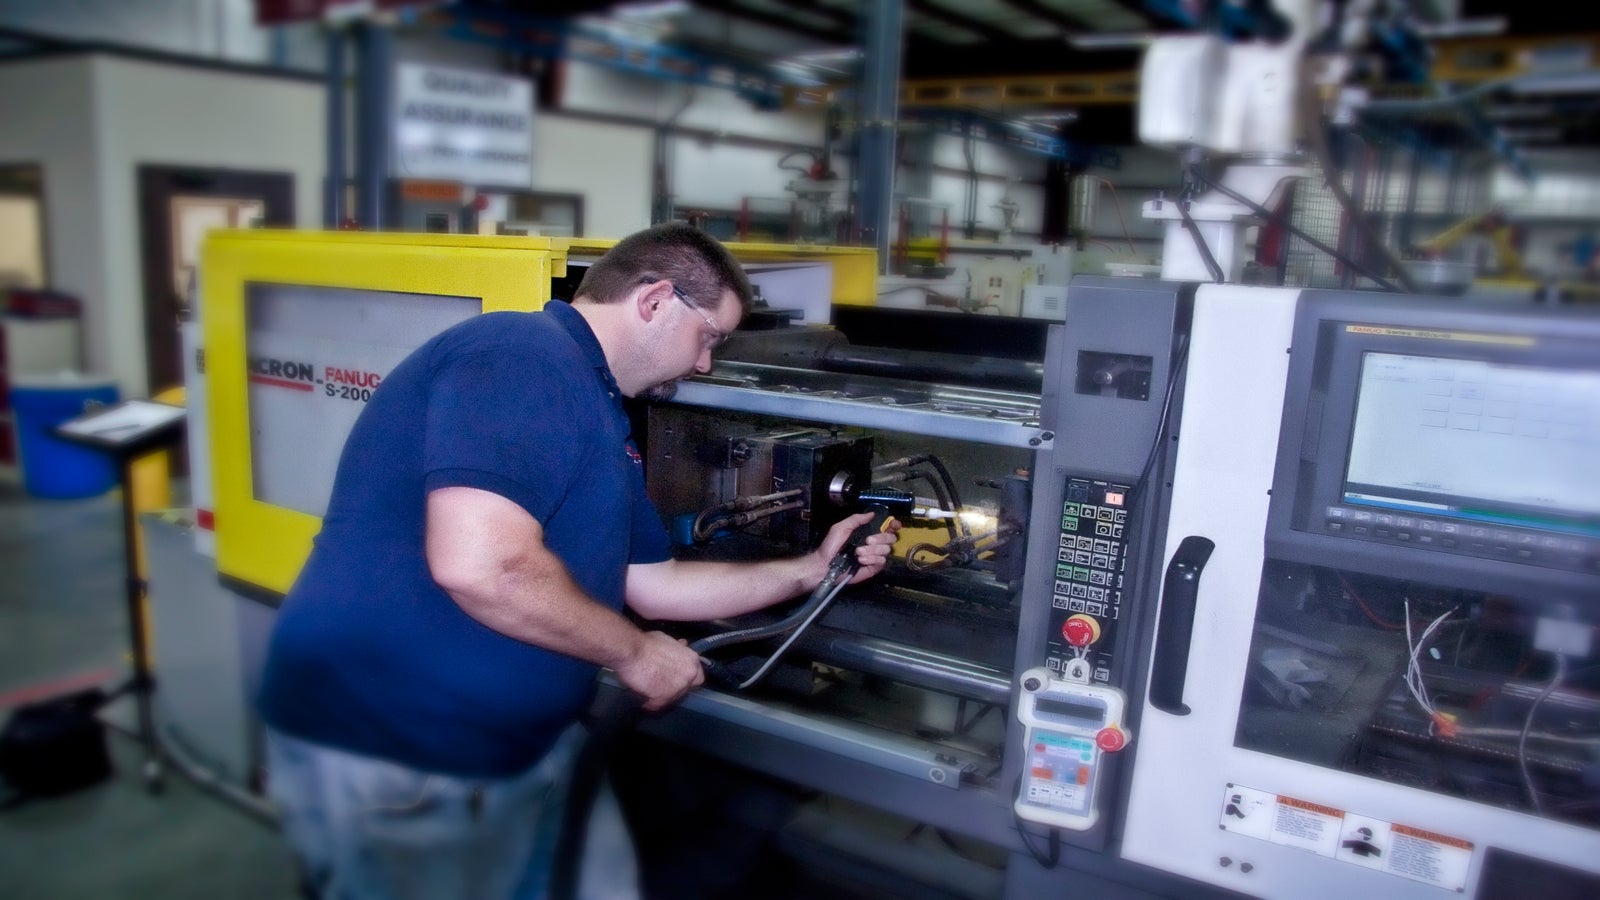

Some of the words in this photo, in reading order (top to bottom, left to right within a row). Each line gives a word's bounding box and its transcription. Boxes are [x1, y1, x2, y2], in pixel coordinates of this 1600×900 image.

[423, 71, 510, 99] QUALITY
[404, 102, 527, 131] ASSURANCE
[325, 367, 381, 388] FANUC
[1291, 799, 1340, 818] WARNING
[1409, 828, 1466, 848] WARNING
